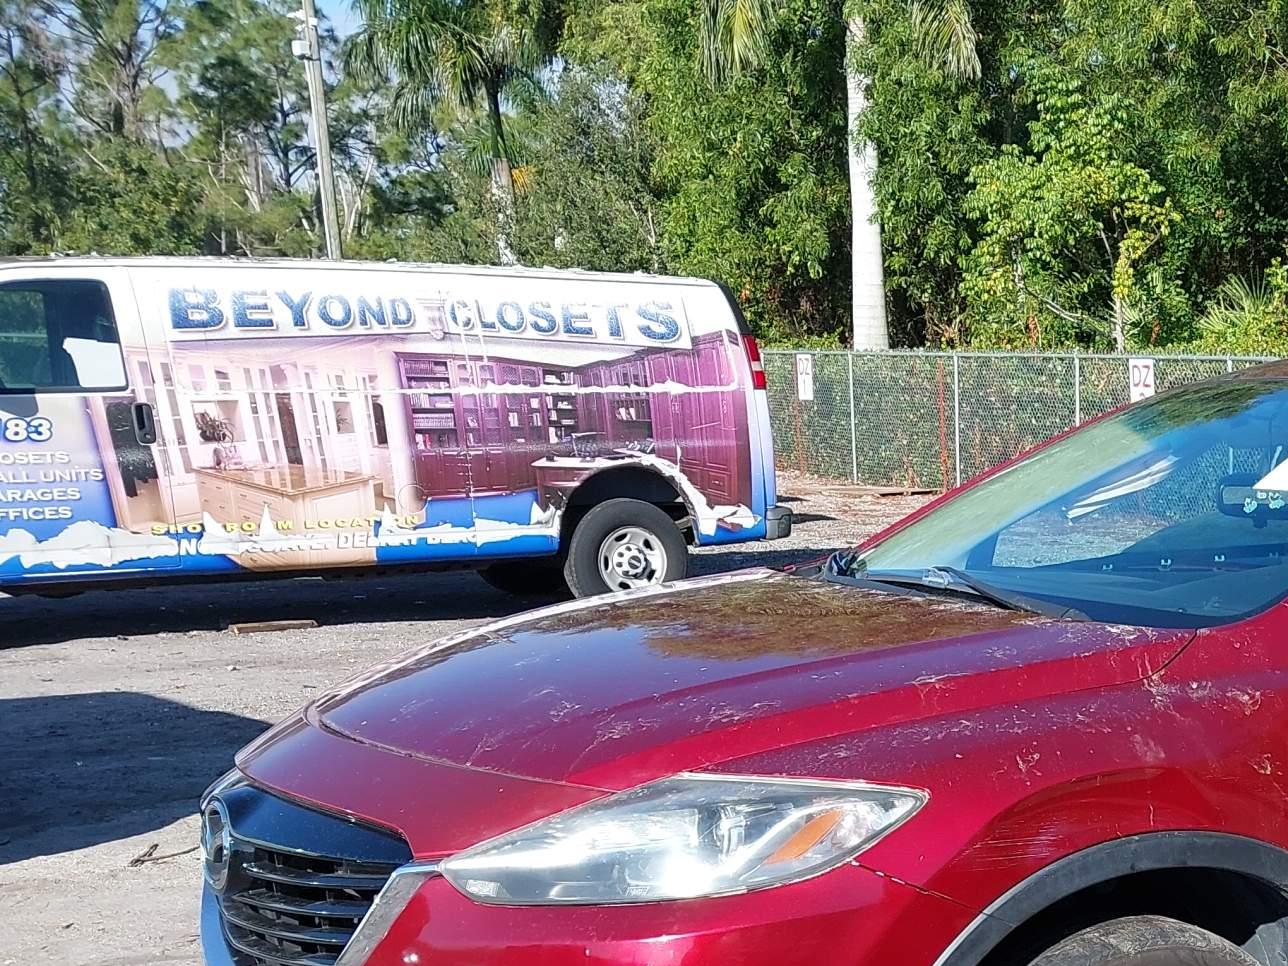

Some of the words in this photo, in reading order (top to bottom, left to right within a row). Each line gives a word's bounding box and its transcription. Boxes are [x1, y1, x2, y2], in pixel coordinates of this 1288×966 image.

[168, 287, 415, 331] BEYOND
[448, 299, 680, 342] CLOSETS
[1132, 364, 1151, 388] DZ
[0, 416, 53, 443] 83
[40, 467, 105, 483] UNITS
[304, 515, 418, 530] LOCATON
